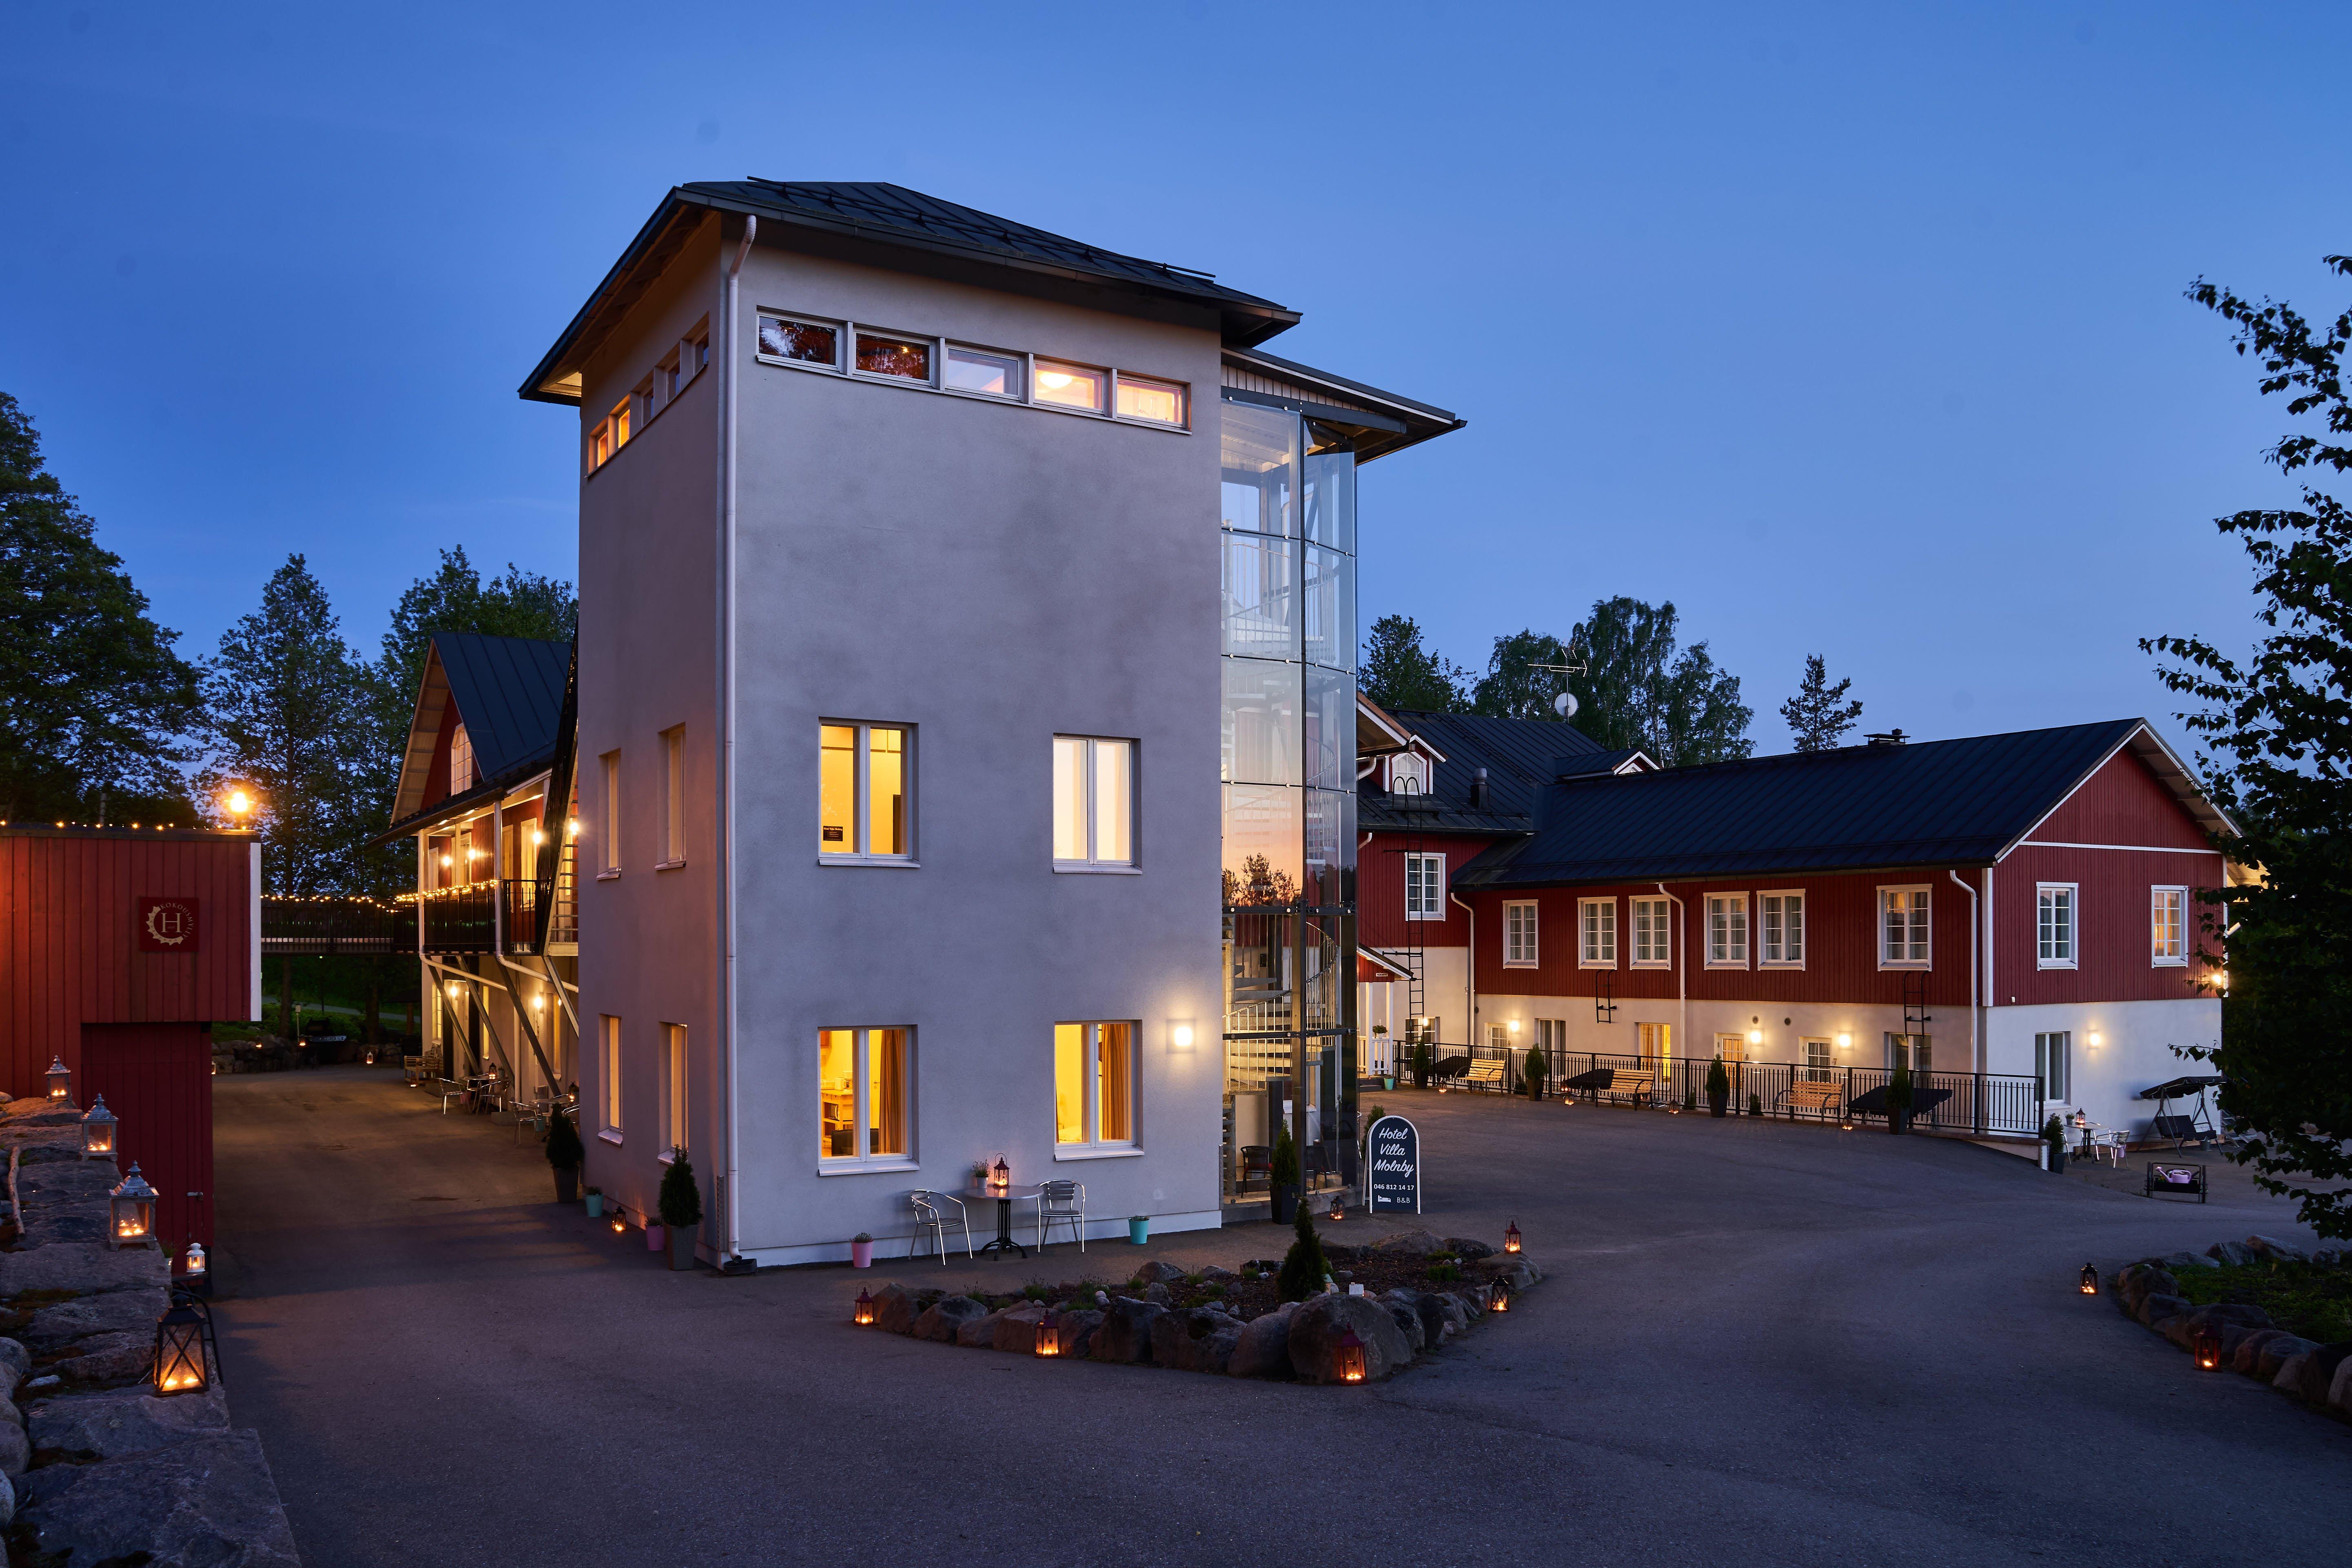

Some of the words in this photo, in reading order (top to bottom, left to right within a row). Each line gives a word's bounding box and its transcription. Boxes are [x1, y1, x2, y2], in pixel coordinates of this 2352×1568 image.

[160, 902, 194, 939] KOKOUSMYLLY
[160, 913, 182, 933] H
[1379, 1127, 1408, 1140] Hotel
[1380, 1143, 1405, 1155] Villa
[1374, 1159, 1414, 1178] Molnby
